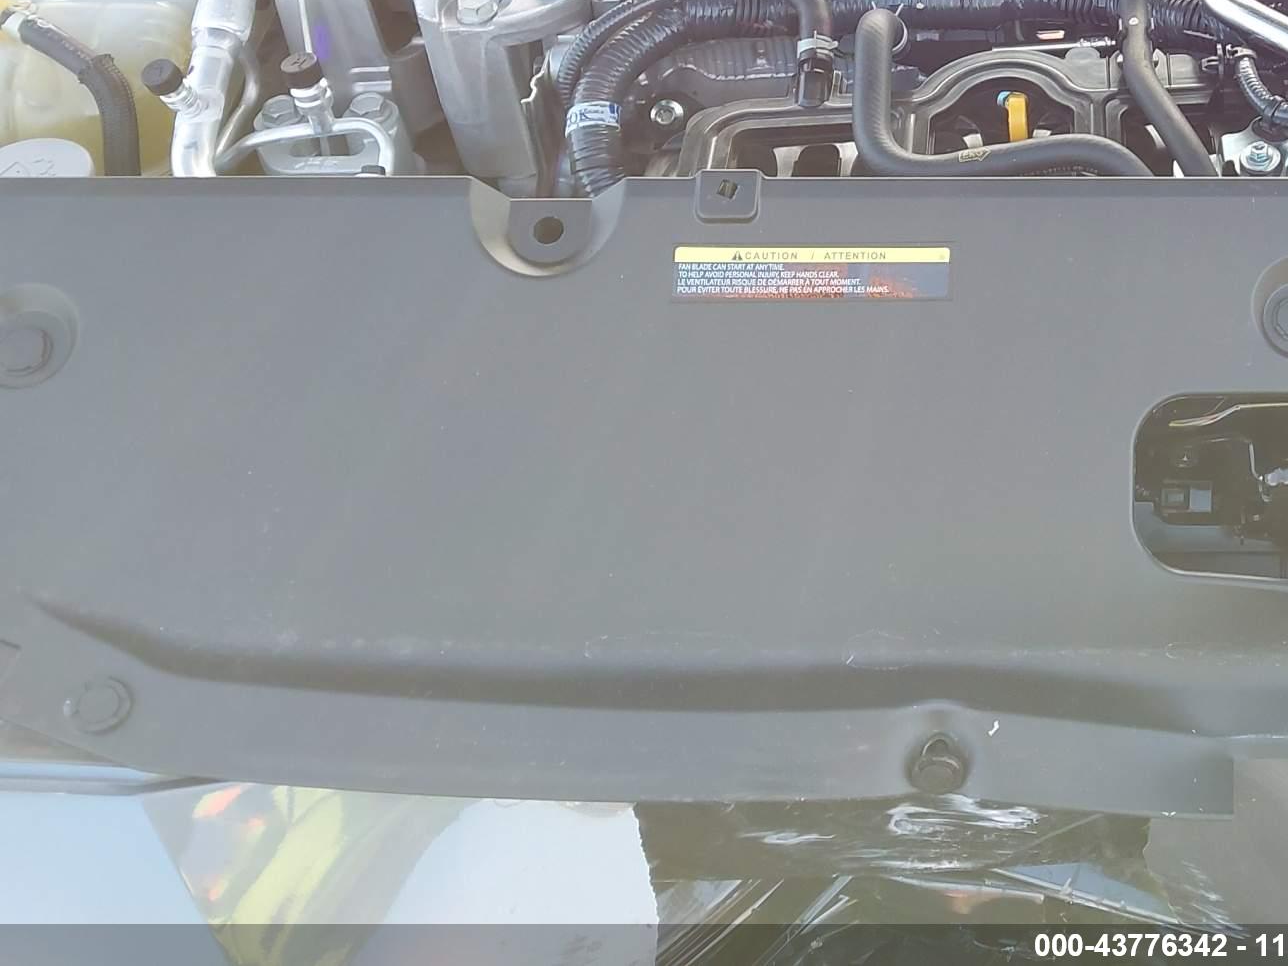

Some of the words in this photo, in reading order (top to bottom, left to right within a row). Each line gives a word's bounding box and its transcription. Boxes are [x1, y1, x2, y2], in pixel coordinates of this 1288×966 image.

[745, 250, 799, 261] CAUTION
[823, 250, 887, 261] ATTENTION
[678, 263, 691, 271] FAN
[691, 263, 712, 271] BLADE
[712, 263, 727, 271] CAN
[727, 263, 746, 271] START
[746, 263, 754, 271] AT
[679, 270, 688, 279] TO
[688, 270, 704, 279] HELP
[704, 270, 725, 279] AVOID
[725, 270, 757, 279] PERSONAL
[780, 270, 796, 279] KEEP
[796, 270, 818, 279] HANDS
[677, 278, 686, 286] LE
[686, 278, 731, 286] VENTILATEUR
[731, 278, 757, 286] RISQUE
[757, 278, 767, 286] DE
[811, 278, 830, 286] TOUT
[677, 285, 697, 294] POUR
[720, 285, 743, 294] TOUTE
[779, 285, 789, 294] NE
[789, 285, 803, 294] PAS
[803, 285, 813, 294] EN
[813, 285, 853, 294] APPROCHER
[853, 285, 866, 294] LES
